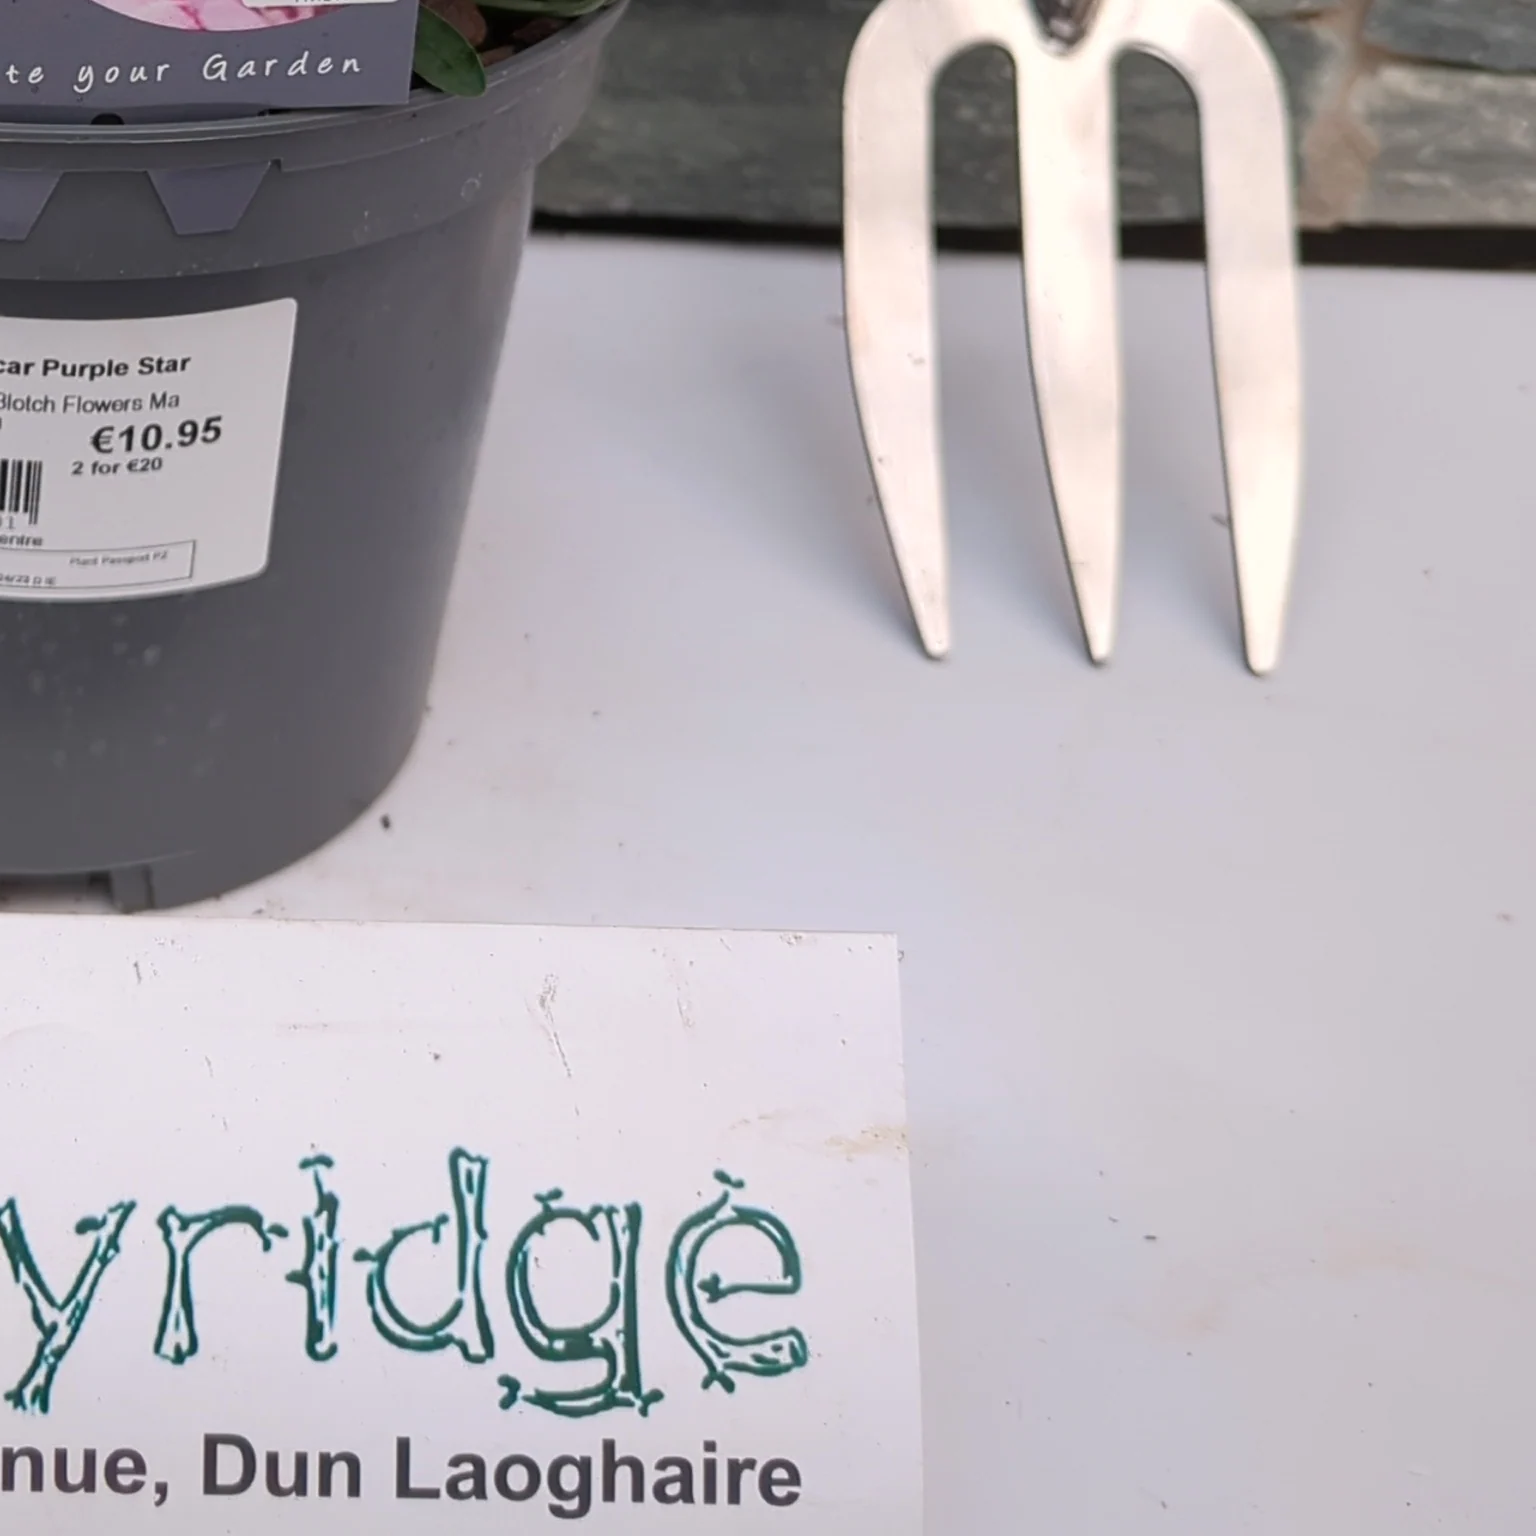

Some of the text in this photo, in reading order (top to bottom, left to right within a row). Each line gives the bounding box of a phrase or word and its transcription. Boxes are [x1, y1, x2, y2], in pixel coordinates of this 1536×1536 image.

[73, 61, 170, 94] your
[202, 51, 363, 83] Garden
[42, 358, 129, 381] Purple
[138, 356, 192, 375] Star
[63, 394, 143, 414] Flowers
[149, 391, 180, 410] Ma
[90, 415, 223, 454] €10.95
[71, 457, 164, 476] 2 for €20
[202, 1432, 362, 1498] Dun
[395, 1436, 802, 1519] Laoghaire
